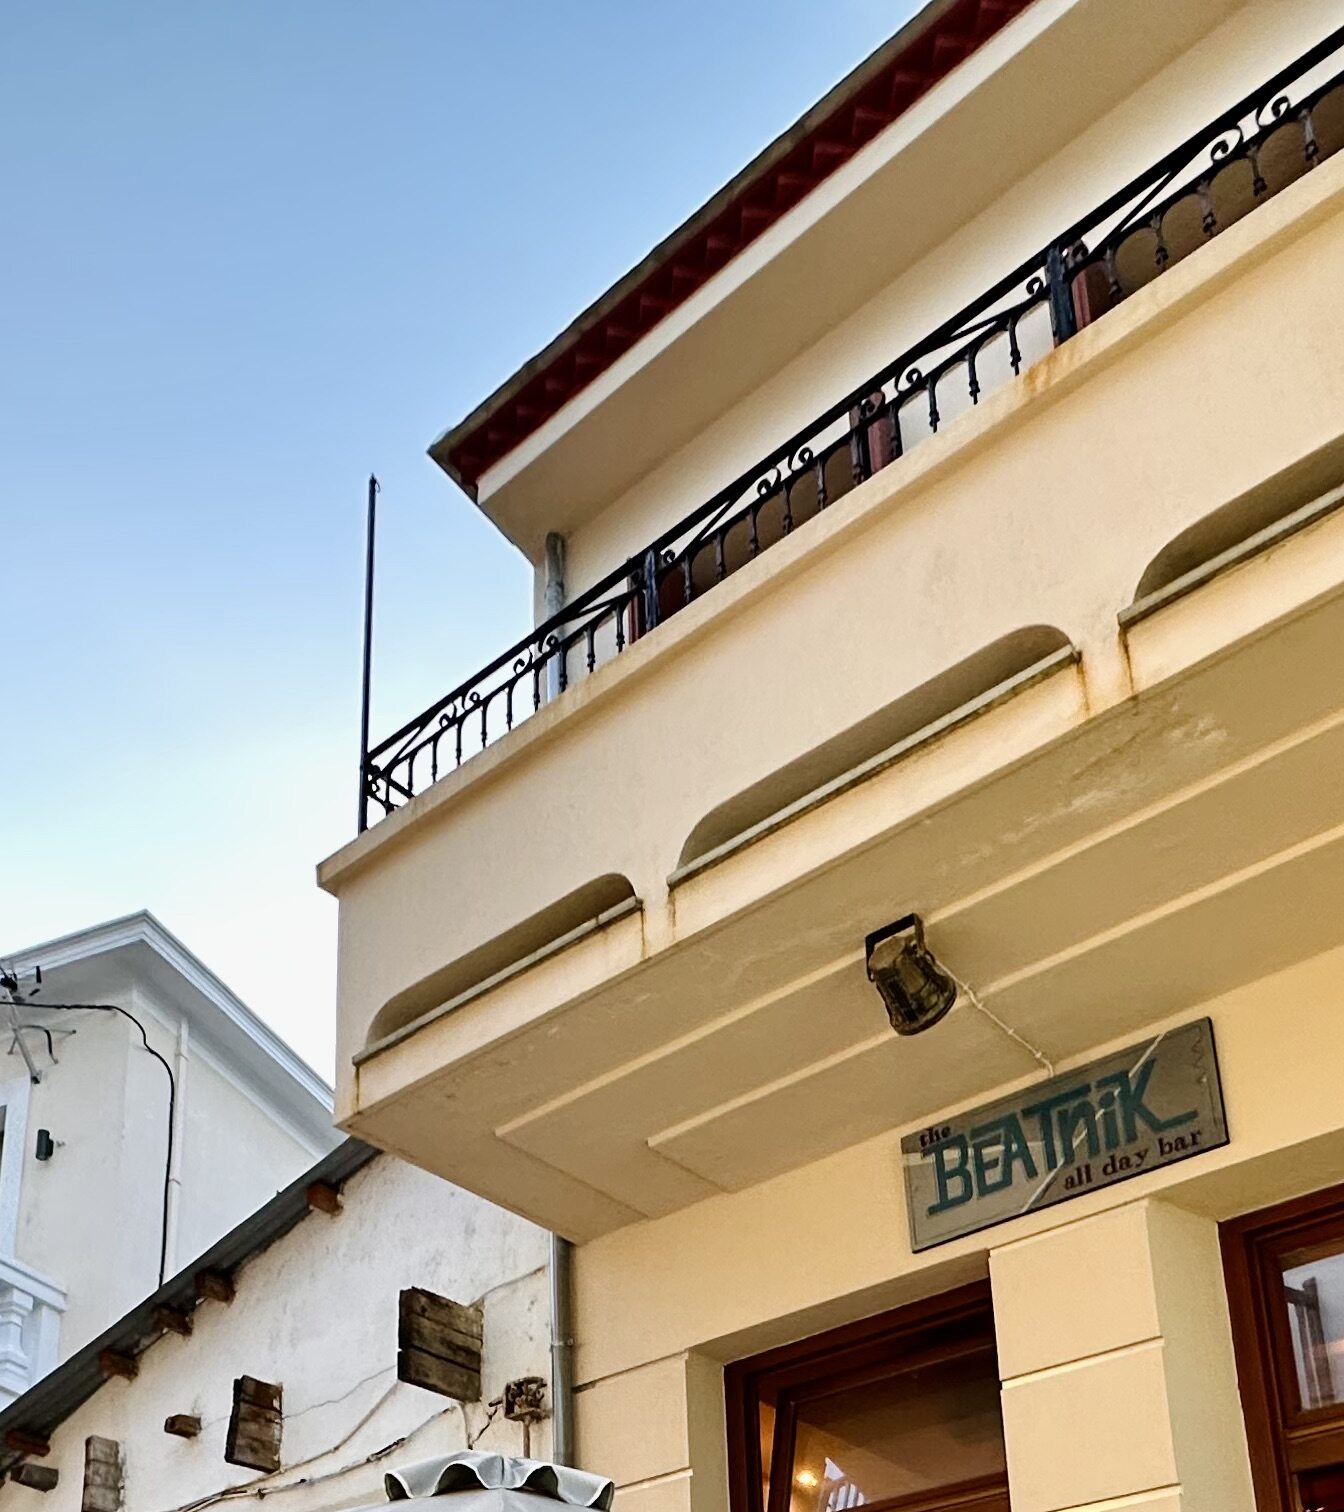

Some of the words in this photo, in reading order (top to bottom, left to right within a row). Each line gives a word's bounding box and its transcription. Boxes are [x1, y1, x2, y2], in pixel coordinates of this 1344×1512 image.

[919, 1124, 952, 1149] the
[1064, 1164, 1093, 1192] all
[1102, 1147, 1150, 1179] day
[1158, 1127, 1203, 1158] bar
